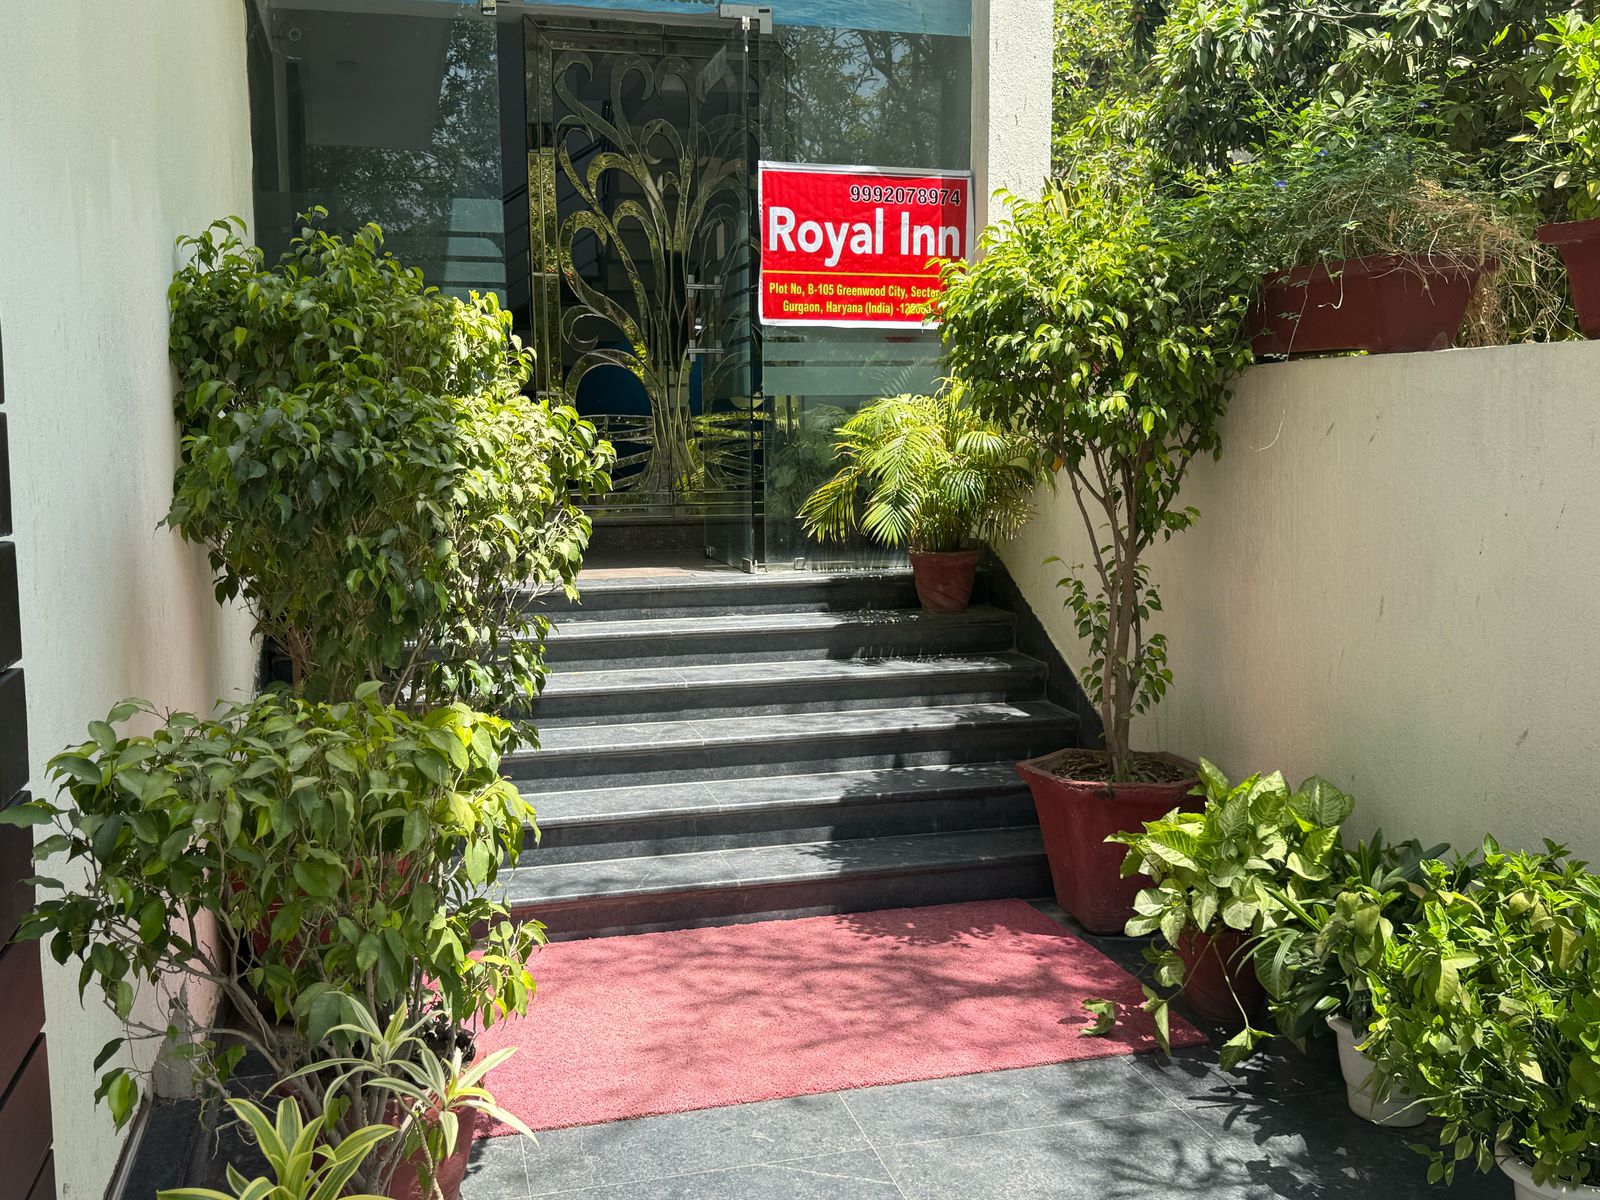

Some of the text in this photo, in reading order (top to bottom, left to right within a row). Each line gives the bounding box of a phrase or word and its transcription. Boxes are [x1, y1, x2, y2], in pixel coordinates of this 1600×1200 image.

[850, 184, 961, 206] 9992078974
[769, 206, 960, 267] Royal Inn
[769, 282, 787, 294] Plot
[790, 283, 805, 297] No,
[808, 284, 834, 296] B-105
[837, 284, 886, 297] Greenwood
[888, 285, 908, 300] City,
[783, 300, 823, 315] Gurgaon,
[826, 301, 863, 315] Haryana
[865, 302, 894, 317] (India)
